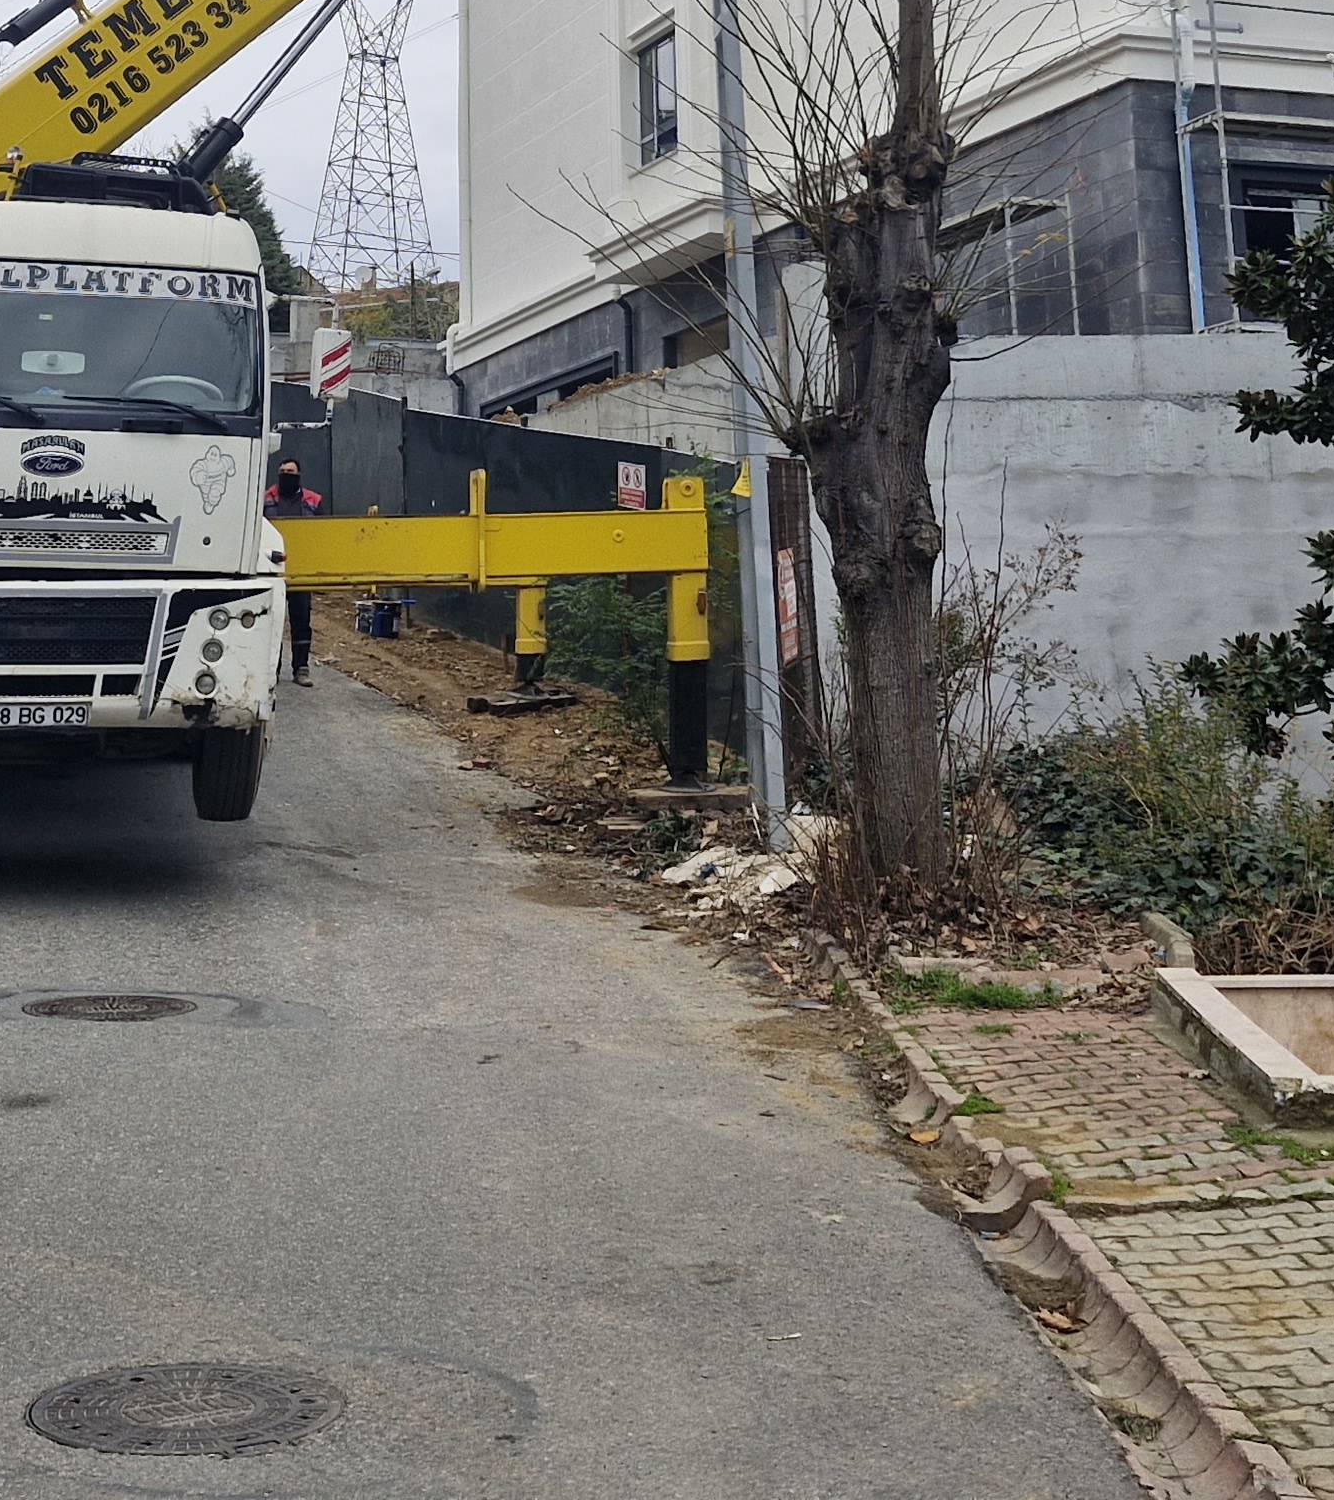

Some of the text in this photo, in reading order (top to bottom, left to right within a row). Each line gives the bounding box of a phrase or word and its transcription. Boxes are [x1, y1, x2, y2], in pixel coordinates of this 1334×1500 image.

[69, 65, 151, 135] 0216
[146, 18, 209, 75] 523
[35, 456, 70, 471] Ford
[18, 707, 45, 724] BG
[52, 706, 86, 724] 029
